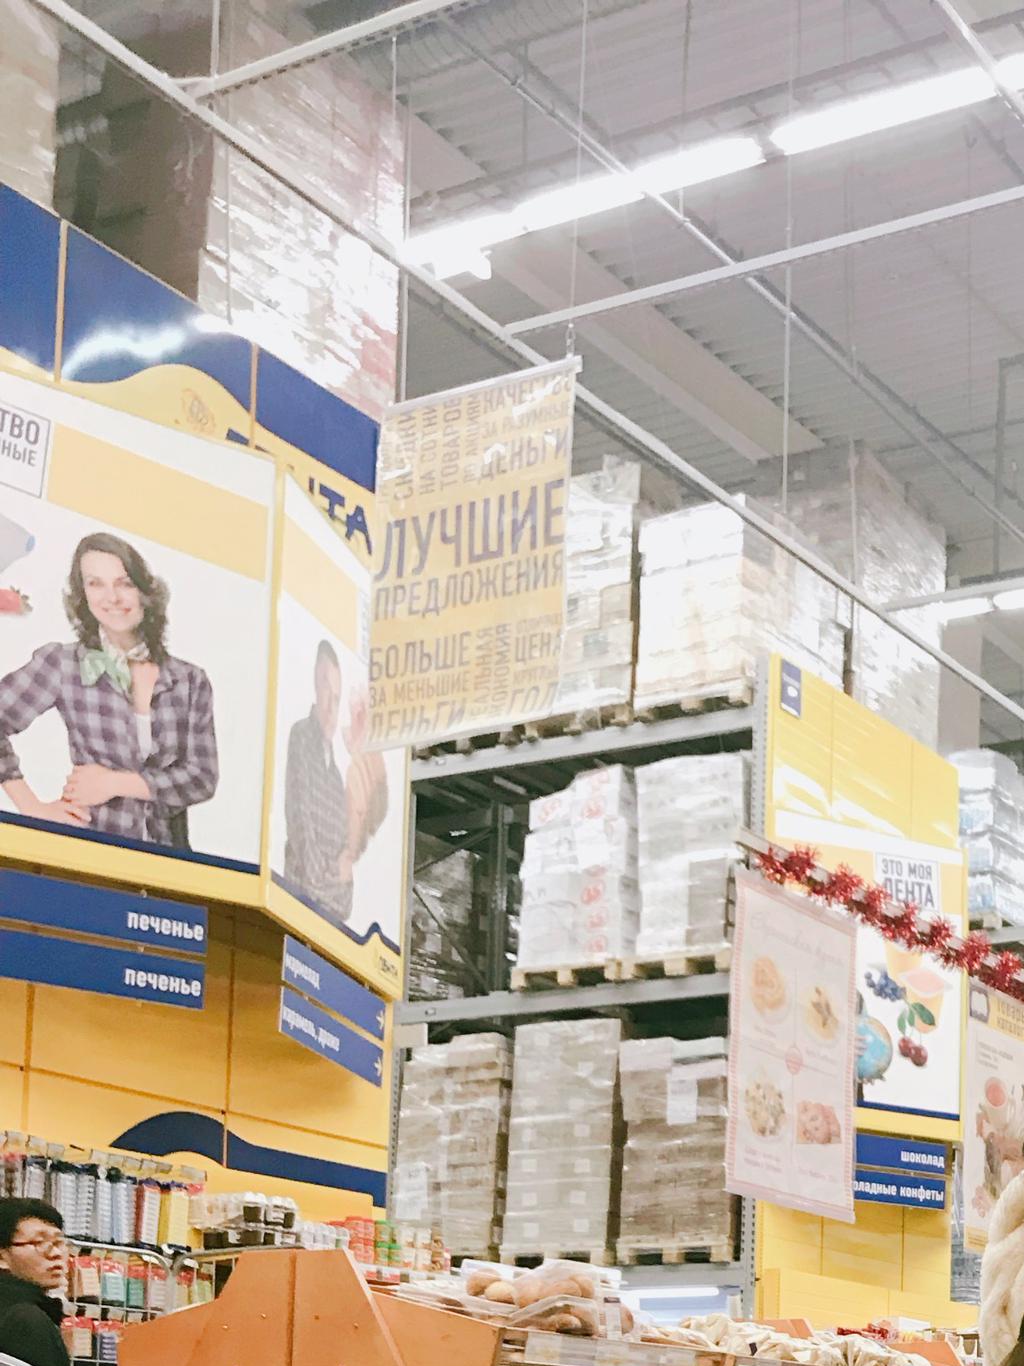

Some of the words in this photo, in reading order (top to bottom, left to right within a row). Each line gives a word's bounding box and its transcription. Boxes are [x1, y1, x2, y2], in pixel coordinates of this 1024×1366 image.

[374, 478, 565, 581] ЛУЧШИЕ
[374, 550, 564, 621] ПРЕДЛОЖЕНИЯ
[369, 630, 472, 681] БОЛЬШЕ
[369, 686, 387, 709] ЗА
[393, 670, 471, 704] МЕНЬШИЕ
[881, 858, 903, 877] ЭТО
[908, 862, 933, 881] МОЯ
[127, 911, 204, 942] печенье
[124, 968, 202, 997] печенье
[900, 1151, 945, 1169] шоколад
[853, 1180, 898, 1196] оладные
[899, 1185, 944, 1202] конфеты
